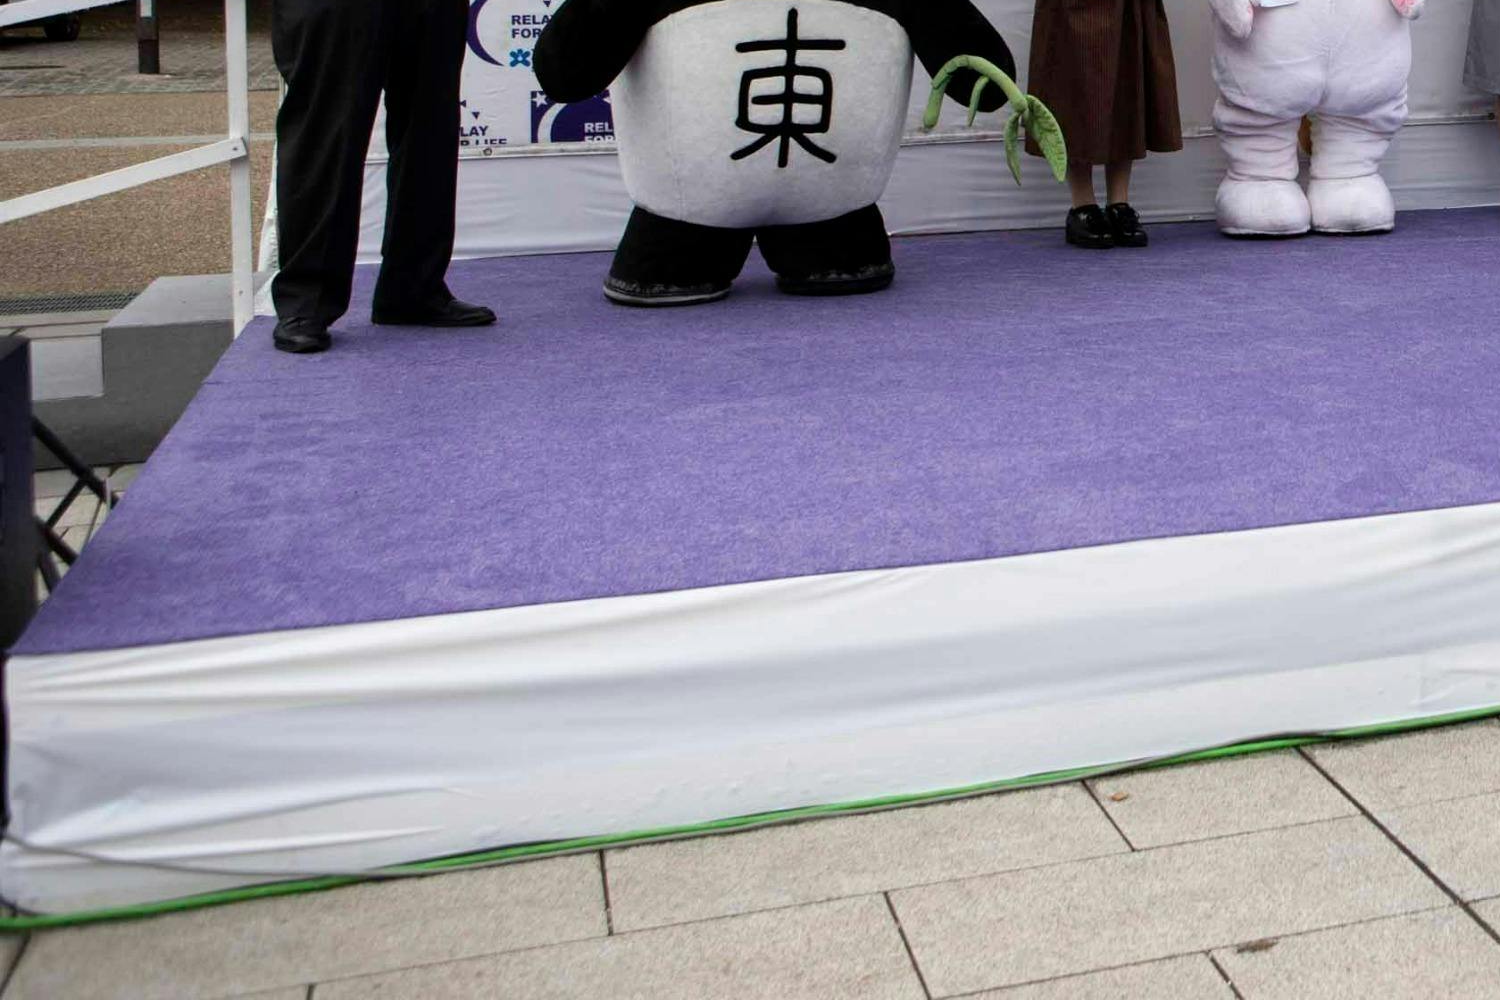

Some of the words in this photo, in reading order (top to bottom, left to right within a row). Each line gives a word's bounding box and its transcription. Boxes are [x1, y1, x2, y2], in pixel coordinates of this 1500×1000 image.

[511, 14, 553, 25] RELA
[730, 7, 846, 168] 東
[584, 122, 614, 133] REL
